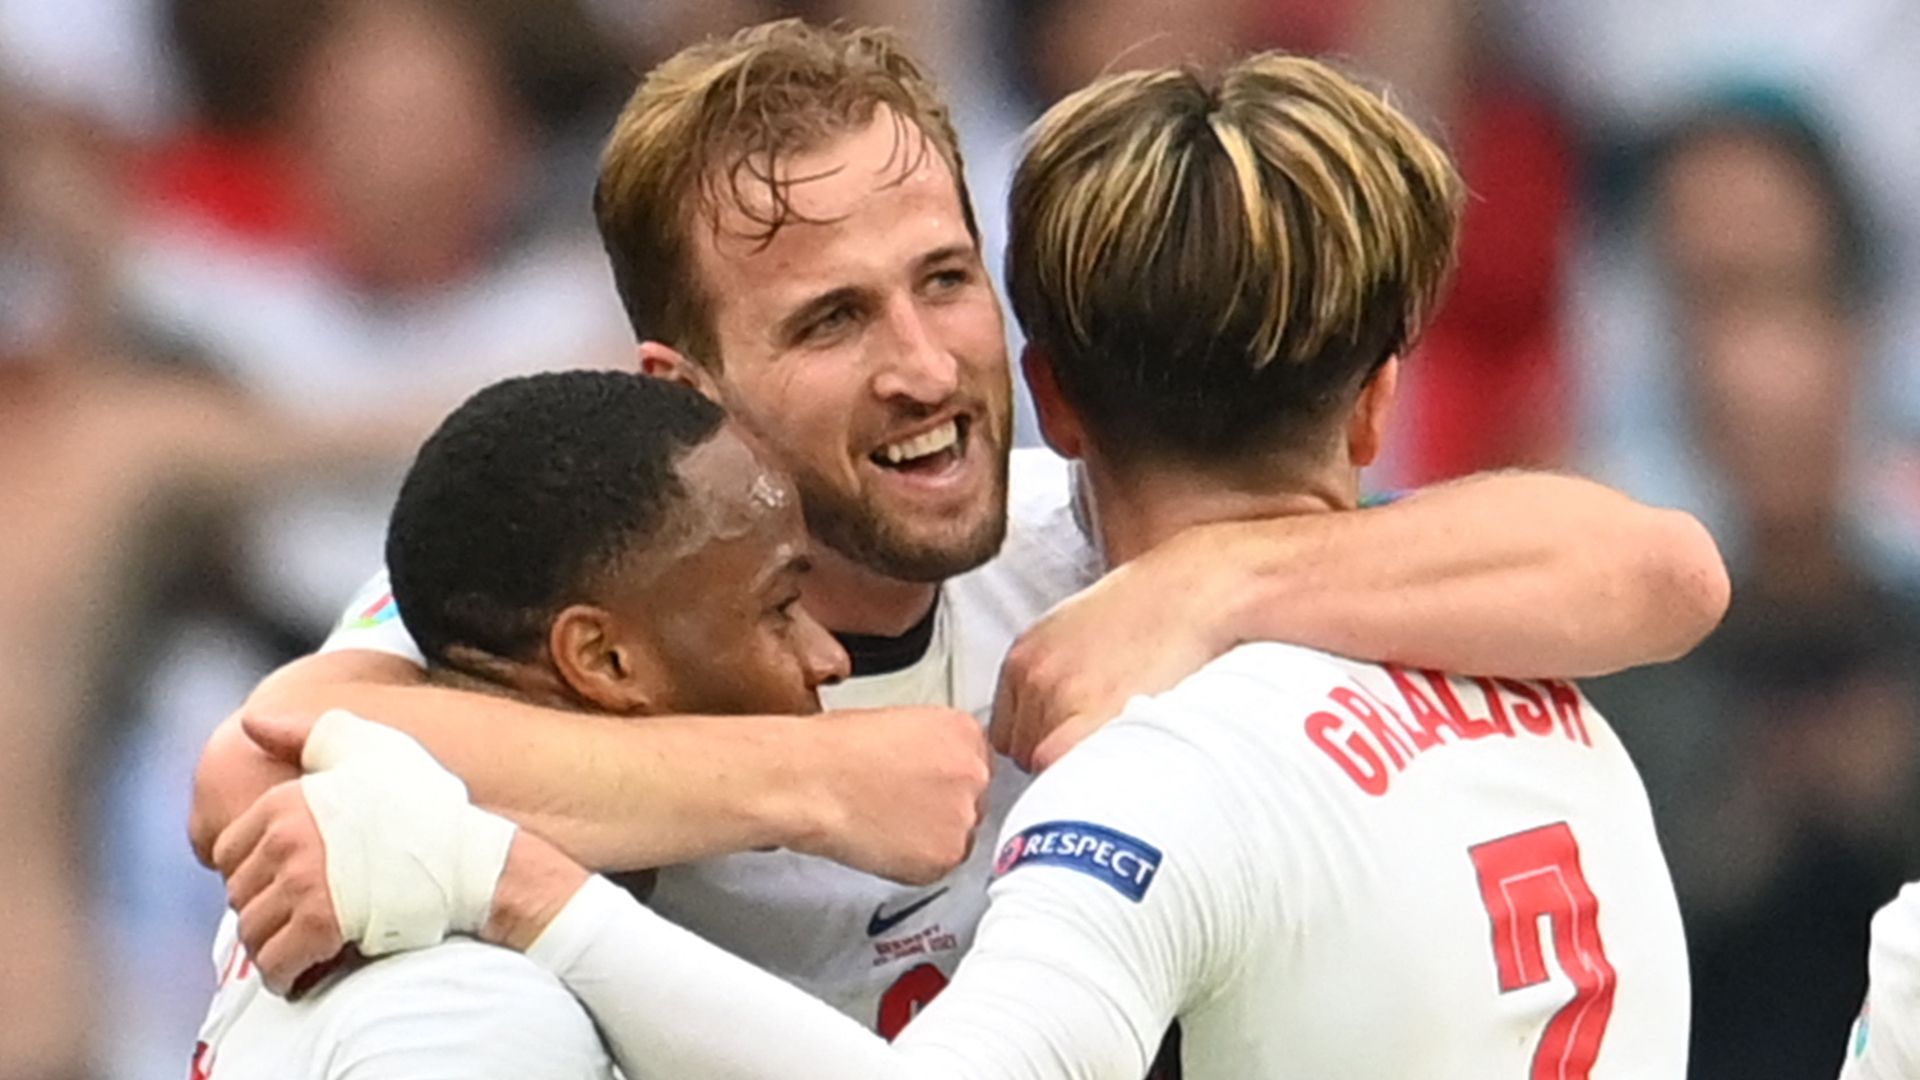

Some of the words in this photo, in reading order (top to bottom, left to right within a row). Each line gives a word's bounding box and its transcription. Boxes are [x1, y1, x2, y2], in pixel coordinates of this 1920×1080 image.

[1305, 661, 1592, 796] GRALISH
[1022, 831, 1154, 885] RESPECT
[1467, 820, 1617, 1080] 7
